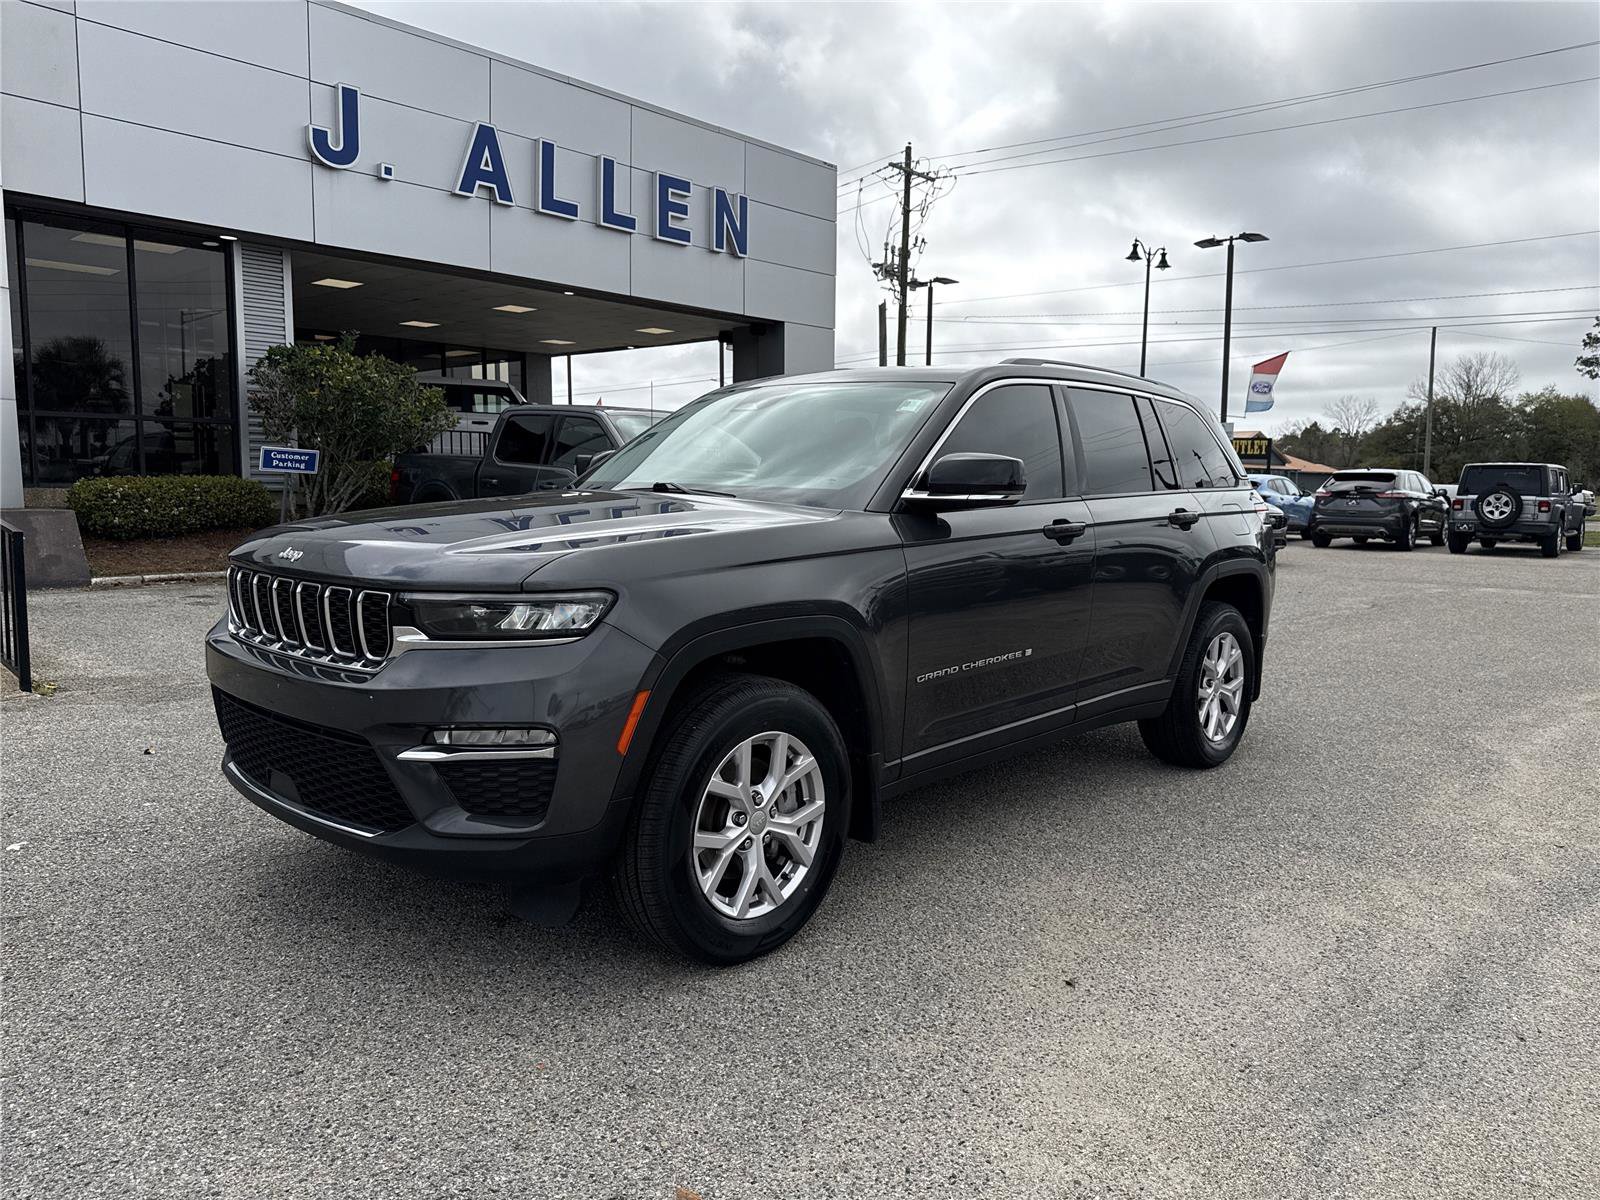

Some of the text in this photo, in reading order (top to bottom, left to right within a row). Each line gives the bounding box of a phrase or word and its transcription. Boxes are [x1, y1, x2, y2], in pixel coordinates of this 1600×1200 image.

[306, 82, 749, 258] J. ALLEN
[1252, 382, 1272, 394] Ford
[271, 451, 310, 461] Customer
[272, 460, 306, 469] Parking
[278, 546, 304, 562] Jeep
[916, 650, 1023, 683] GRAND CHEROKEE
